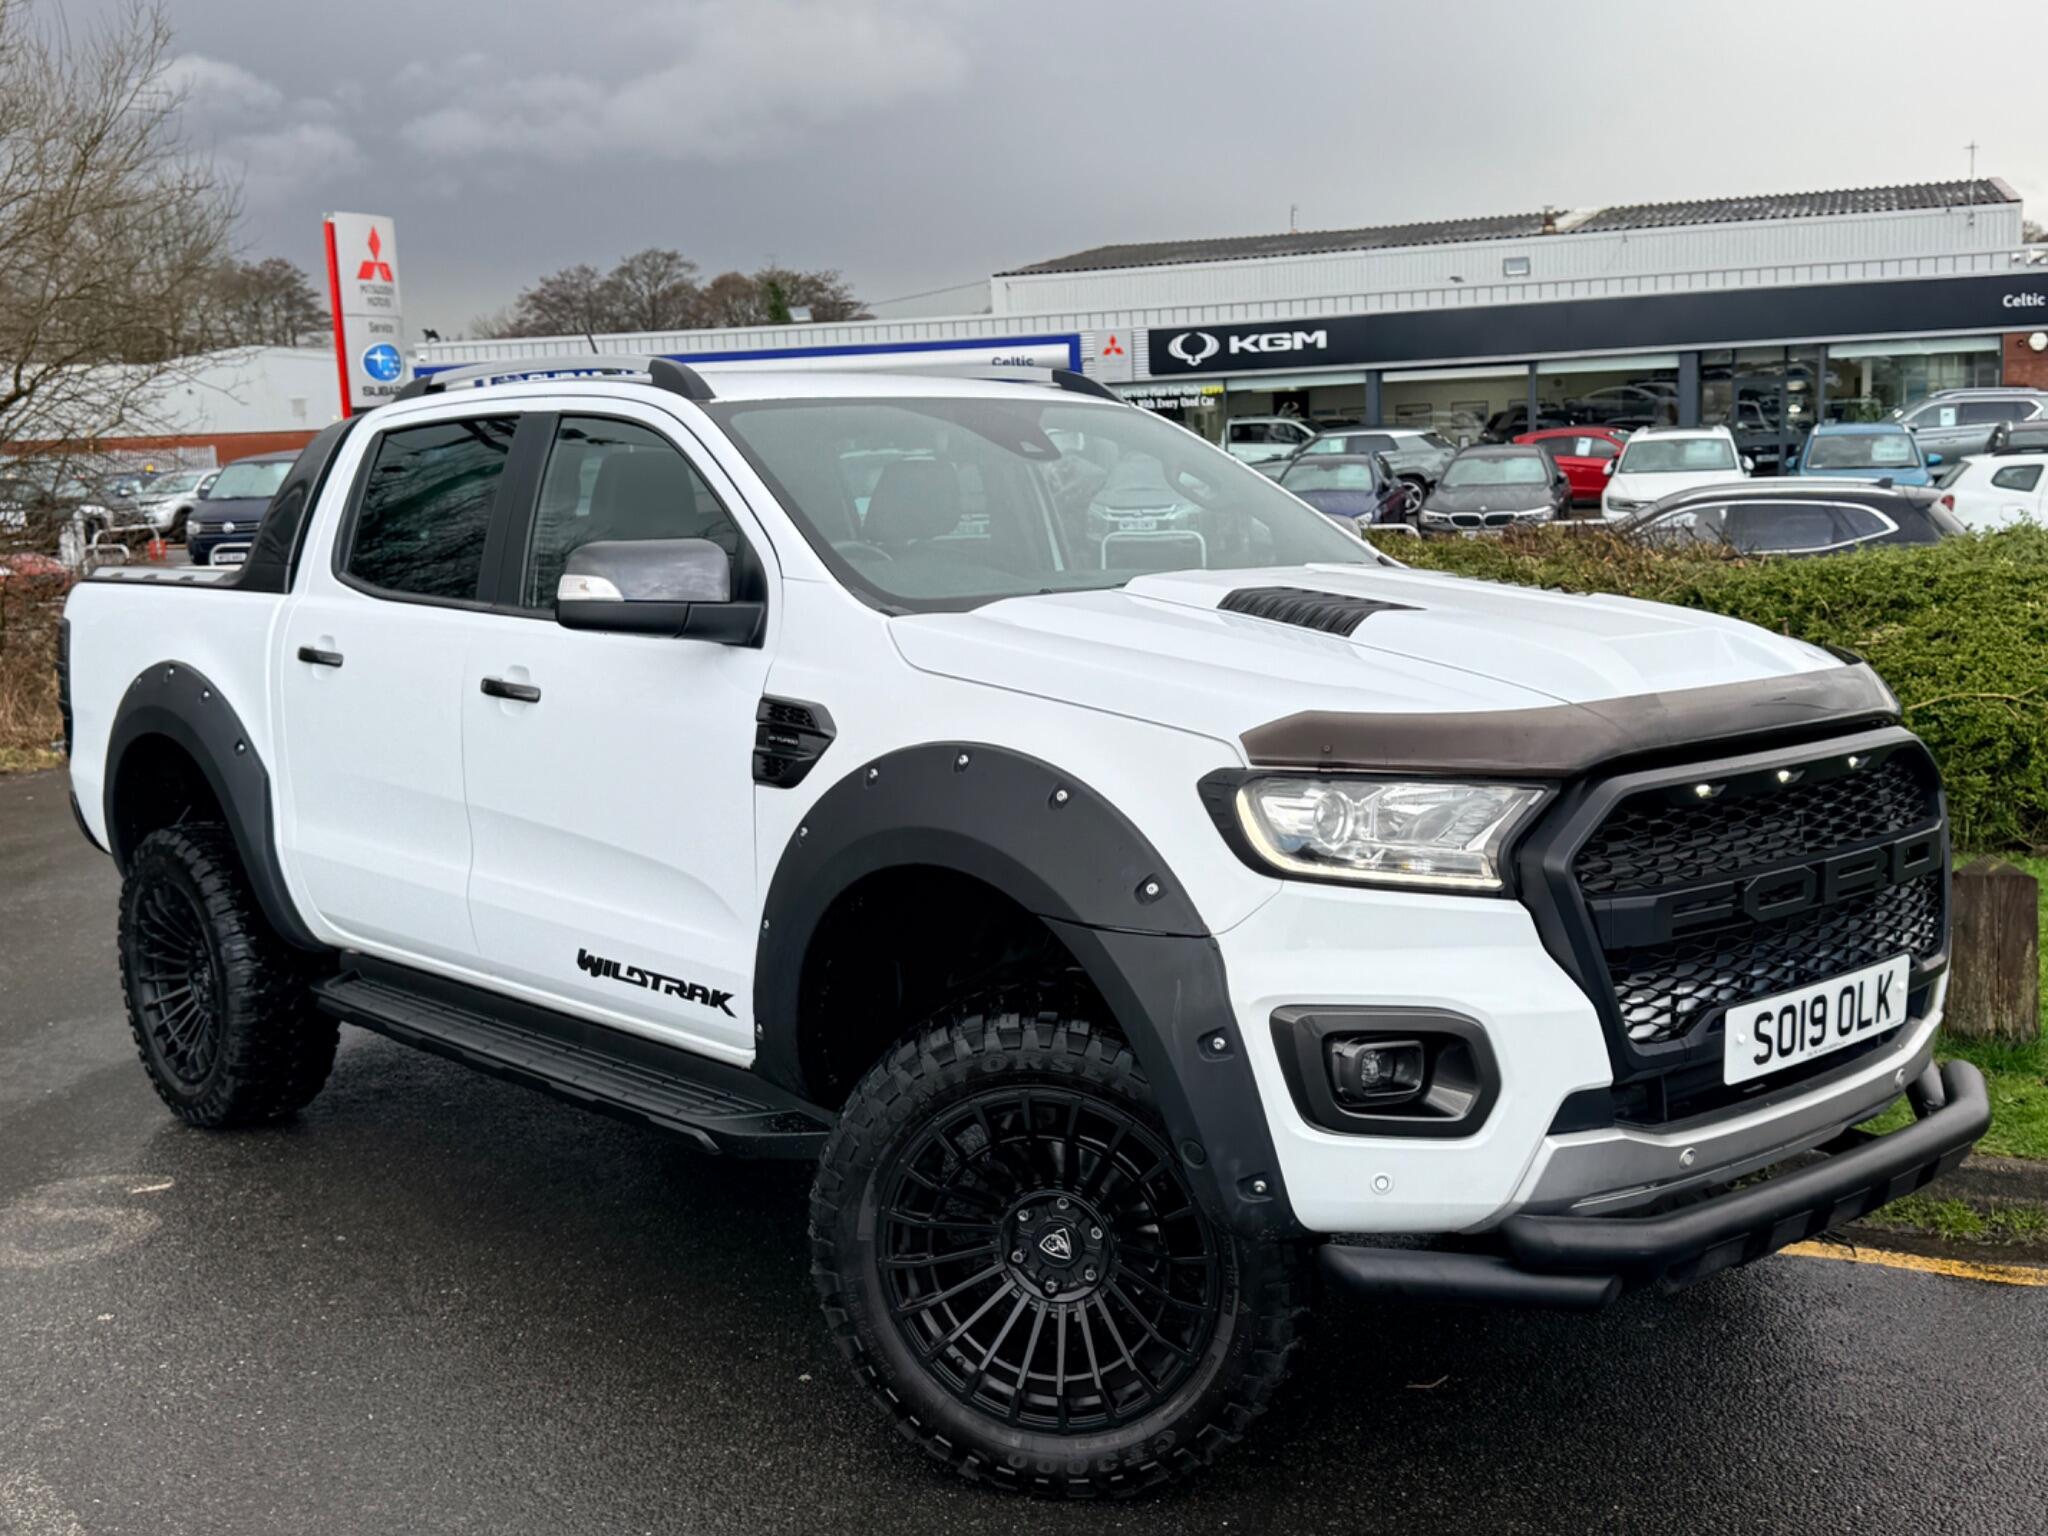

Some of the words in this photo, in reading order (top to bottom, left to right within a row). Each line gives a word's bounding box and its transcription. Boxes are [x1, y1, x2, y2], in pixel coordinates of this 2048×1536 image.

[2002, 292, 2046, 308] Celtic
[1229, 330, 1327, 354] KGM
[991, 355, 1034, 366] Celtic
[1157, 398, 1179, 410] Every
[1180, 397, 1200, 407] Used
[1201, 397, 1215, 406] Car
[1657, 828, 1942, 946] FORD
[577, 948, 738, 1018] WILDTRAK
[1753, 994, 1828, 1066] SO19
[1837, 970, 1894, 1037] OLK
